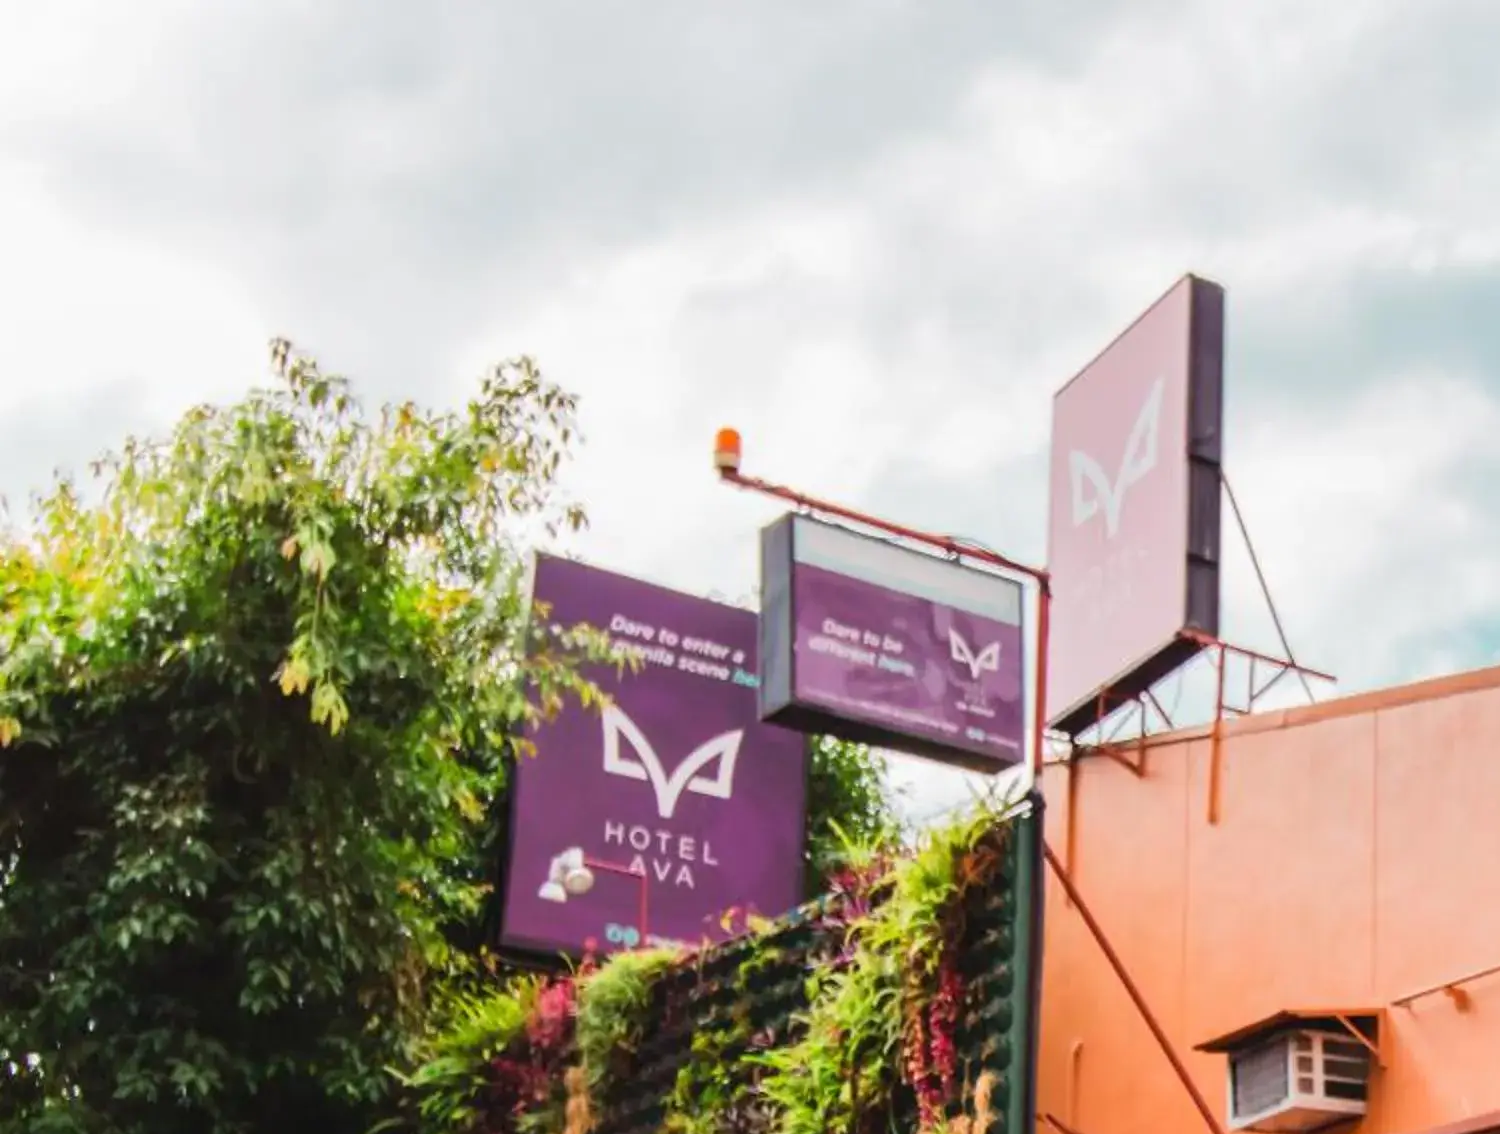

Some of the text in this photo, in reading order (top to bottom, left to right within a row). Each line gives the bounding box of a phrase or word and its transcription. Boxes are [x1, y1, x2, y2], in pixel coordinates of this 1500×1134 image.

[611, 613, 745, 664] Dare to enter a
[678, 656, 730, 681] scene
[604, 821, 719, 866] HOTEL
[628, 854, 696, 890] AVA
